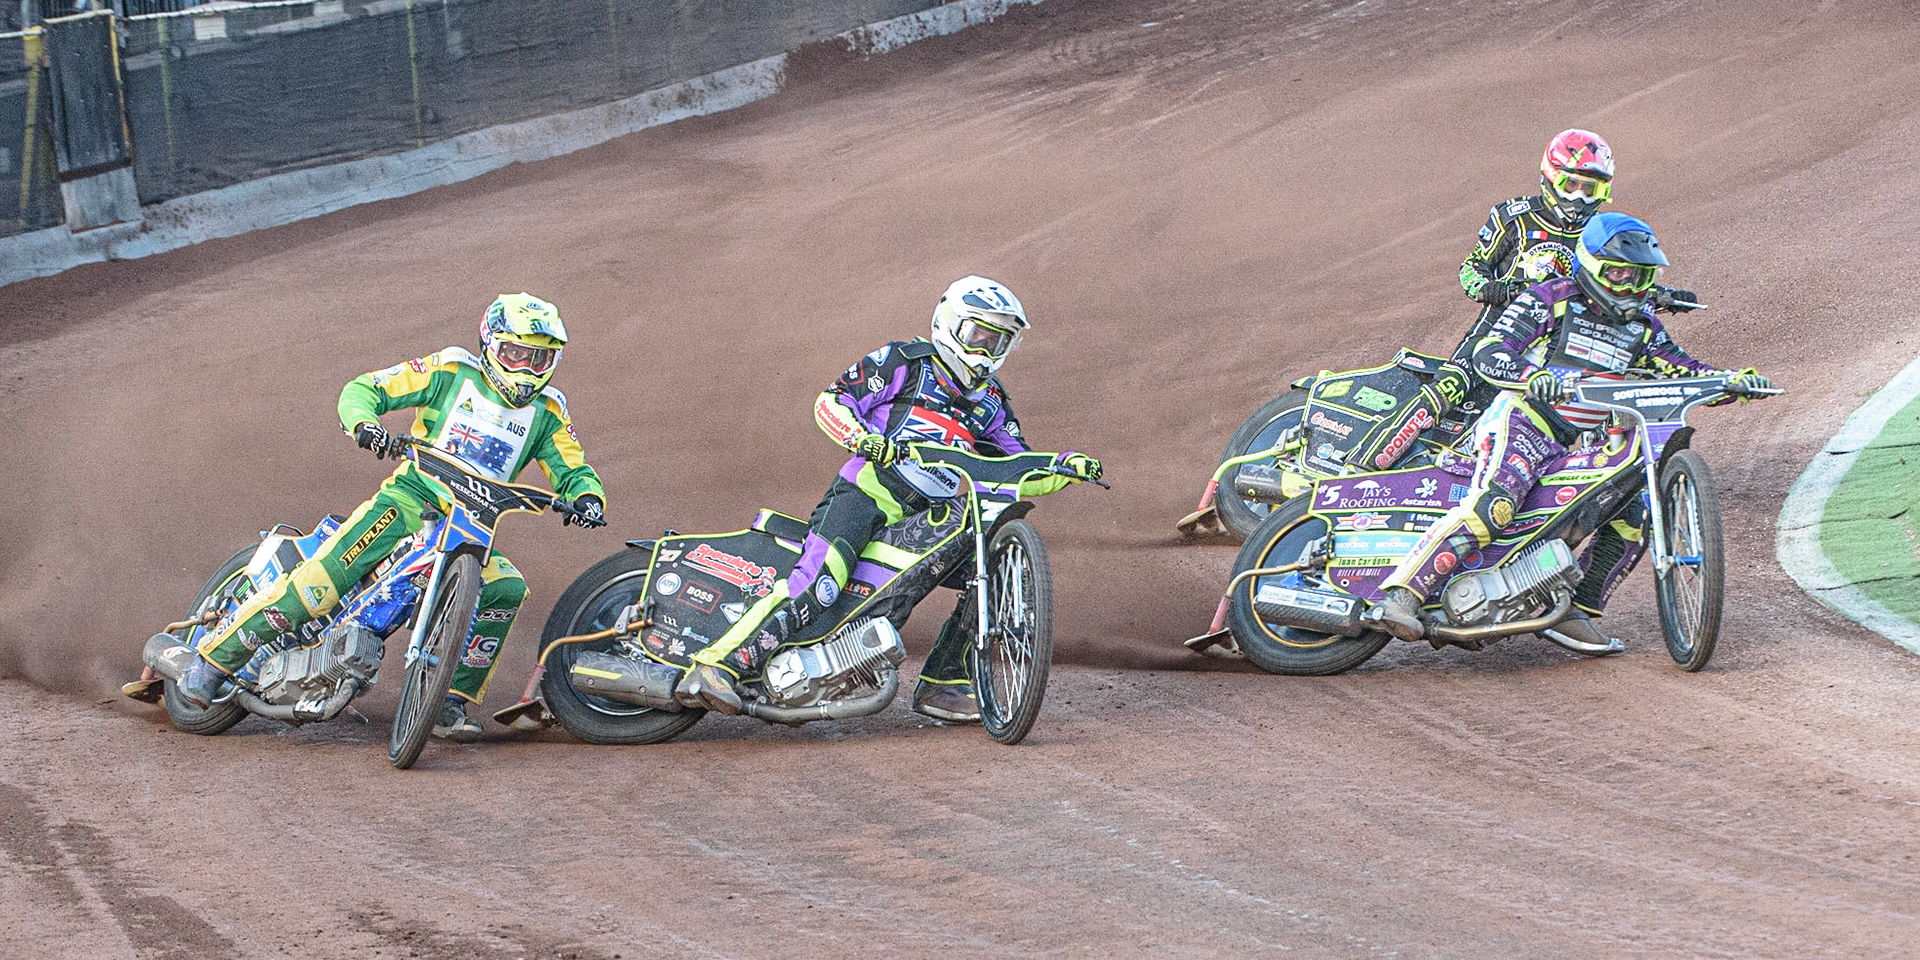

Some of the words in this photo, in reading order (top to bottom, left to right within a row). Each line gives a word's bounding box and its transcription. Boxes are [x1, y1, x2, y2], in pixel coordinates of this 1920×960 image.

[1480, 362, 1520, 380] ROOFING
[1613, 387, 1682, 400] SOUTHBROOK
[506, 421, 526, 437] AUS
[450, 480, 500, 515] WESSEXMARNE
[1362, 486, 1391, 498] JAY'S
[1339, 498, 1397, 508] ROOFING
[344, 543, 365, 563] TRU
[362, 510, 396, 545] PLANT
[686, 586, 714, 603] BOSS
[468, 635, 499, 654] JG
